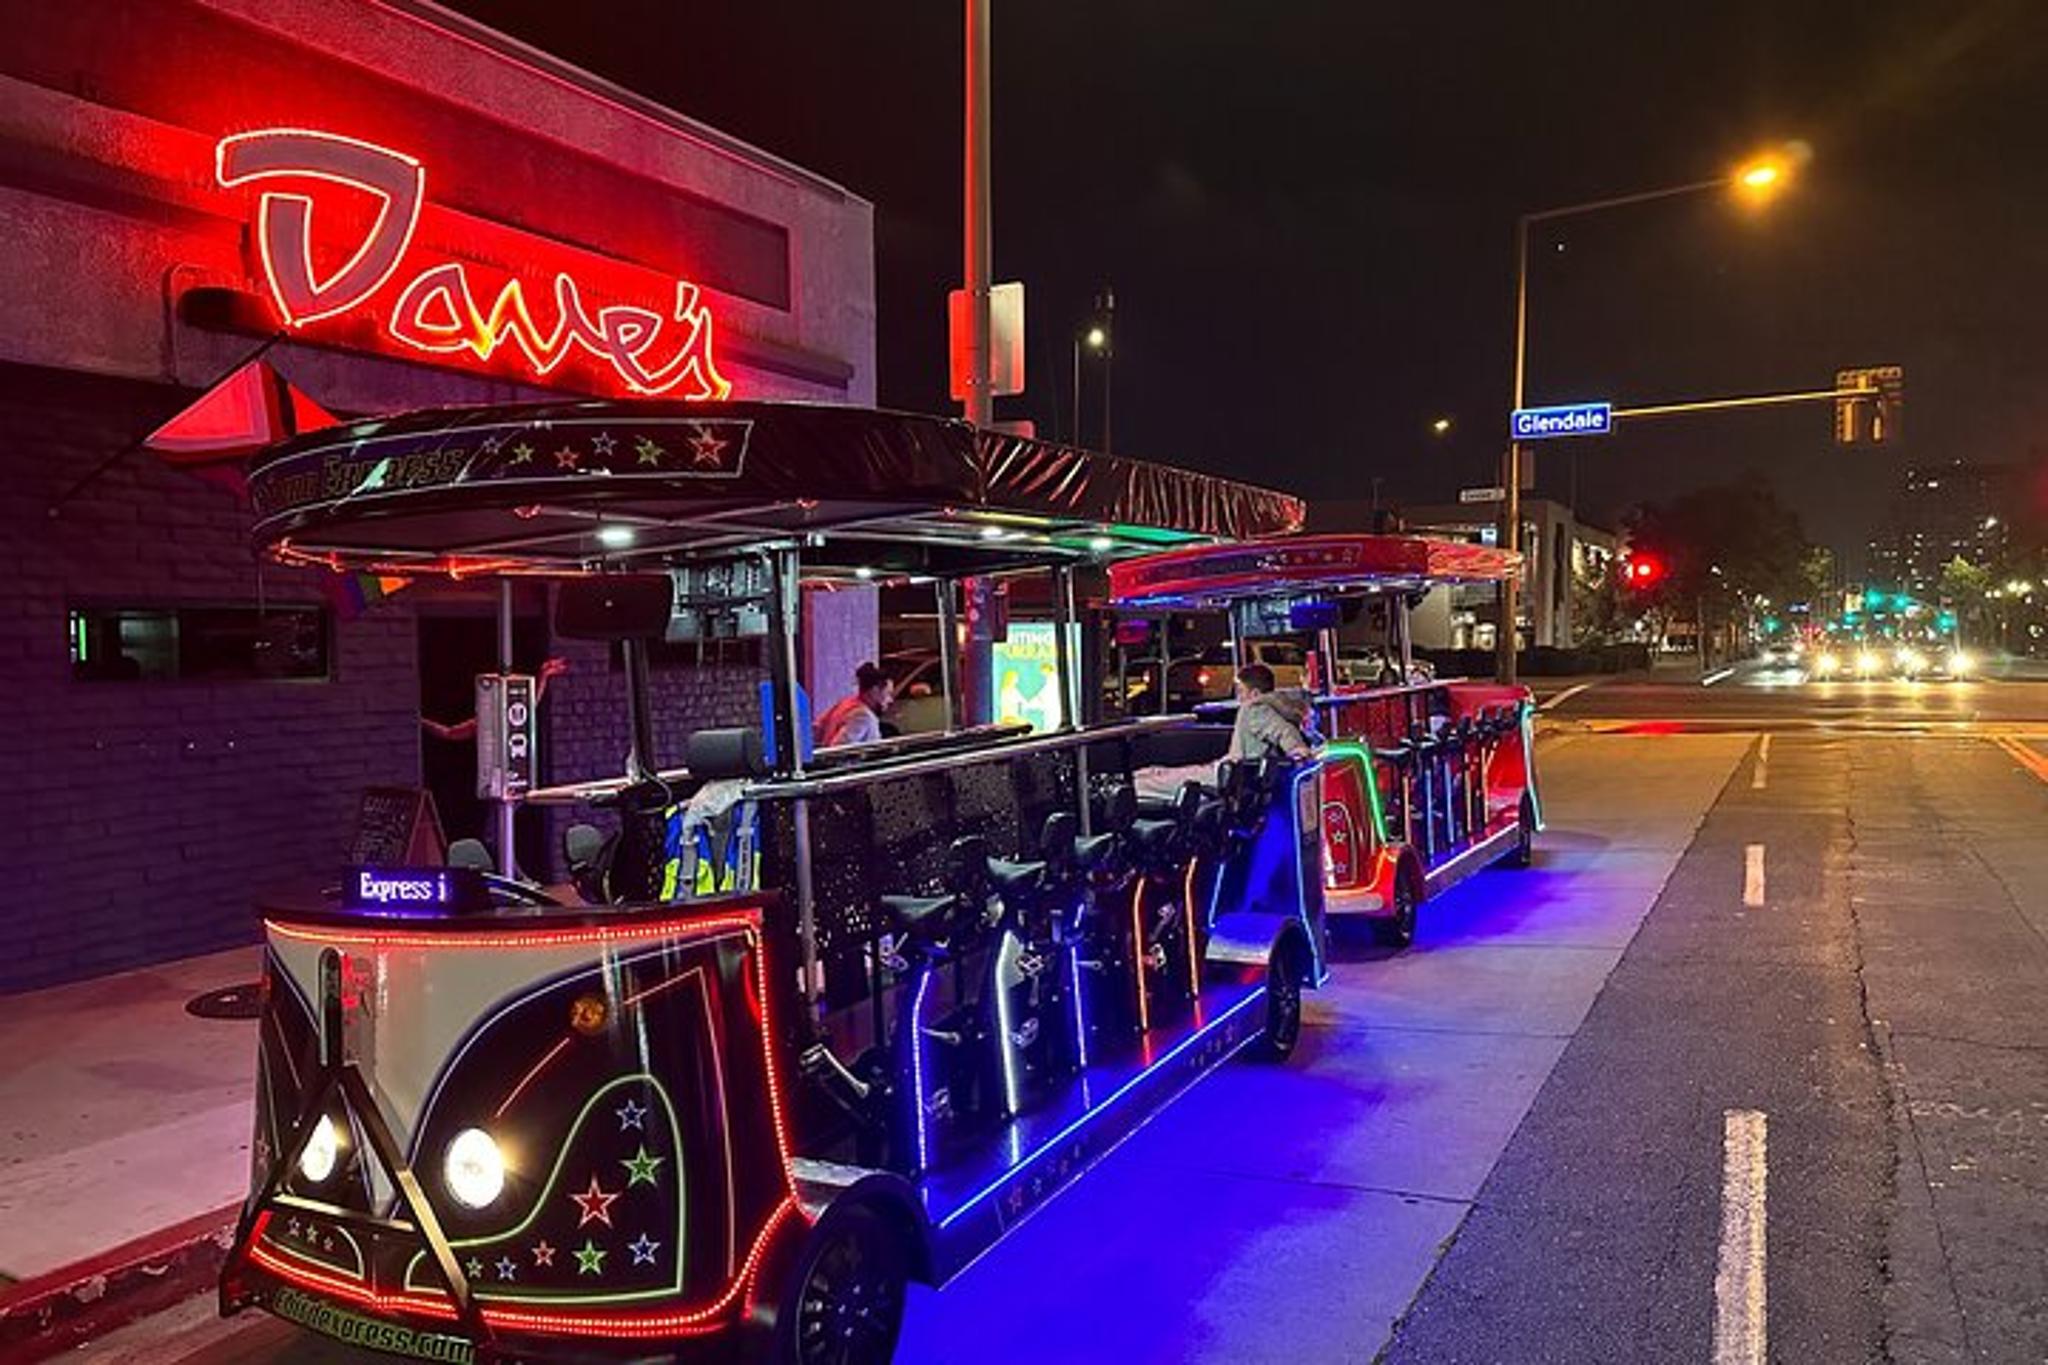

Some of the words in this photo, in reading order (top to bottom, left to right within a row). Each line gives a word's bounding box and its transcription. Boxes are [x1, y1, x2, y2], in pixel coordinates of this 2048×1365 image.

[215, 127, 732, 402] Dave's
[1517, 411, 1605, 433] Glendale
[360, 871, 433, 903] Express
